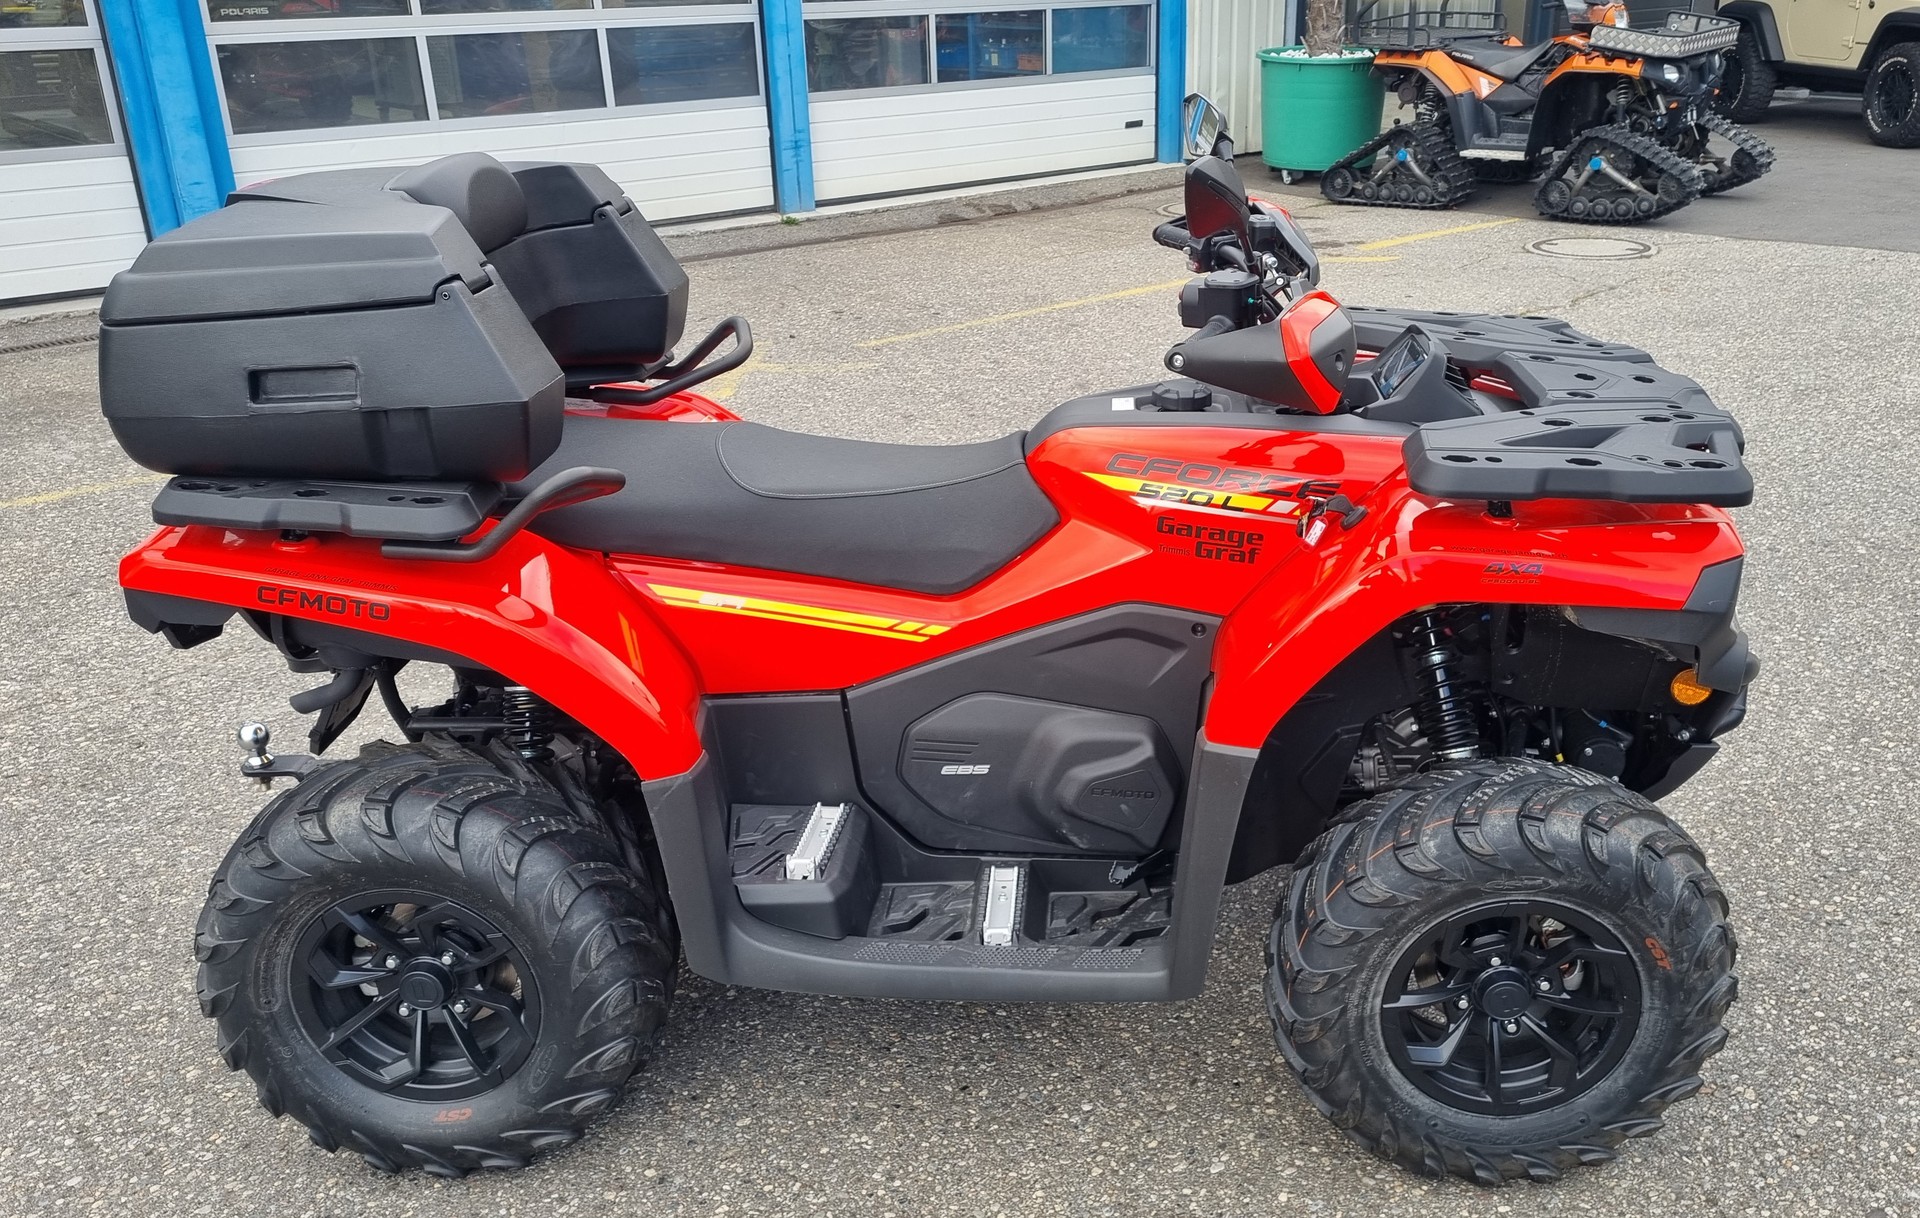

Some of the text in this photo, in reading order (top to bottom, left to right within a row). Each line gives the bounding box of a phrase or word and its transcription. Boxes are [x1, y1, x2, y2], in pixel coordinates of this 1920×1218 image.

[220, 7, 269, 16] POLARIS
[1105, 452, 1343, 500] CFORCE
[1135, 482, 1246, 512] 520 L
[1156, 515, 1265, 549] Garage
[1158, 541, 1263, 565] Trimmis Graf
[264, 566, 300, 577] GARAGE
[358, 580, 399, 592] TRIMMIS
[257, 585, 390, 621] CFMOTO
[940, 764, 991, 775] EBS
[1090, 787, 1155, 799] CFMOTO
[1644, 936, 1673, 971] CST
[432, 1107, 473, 1124] CST
